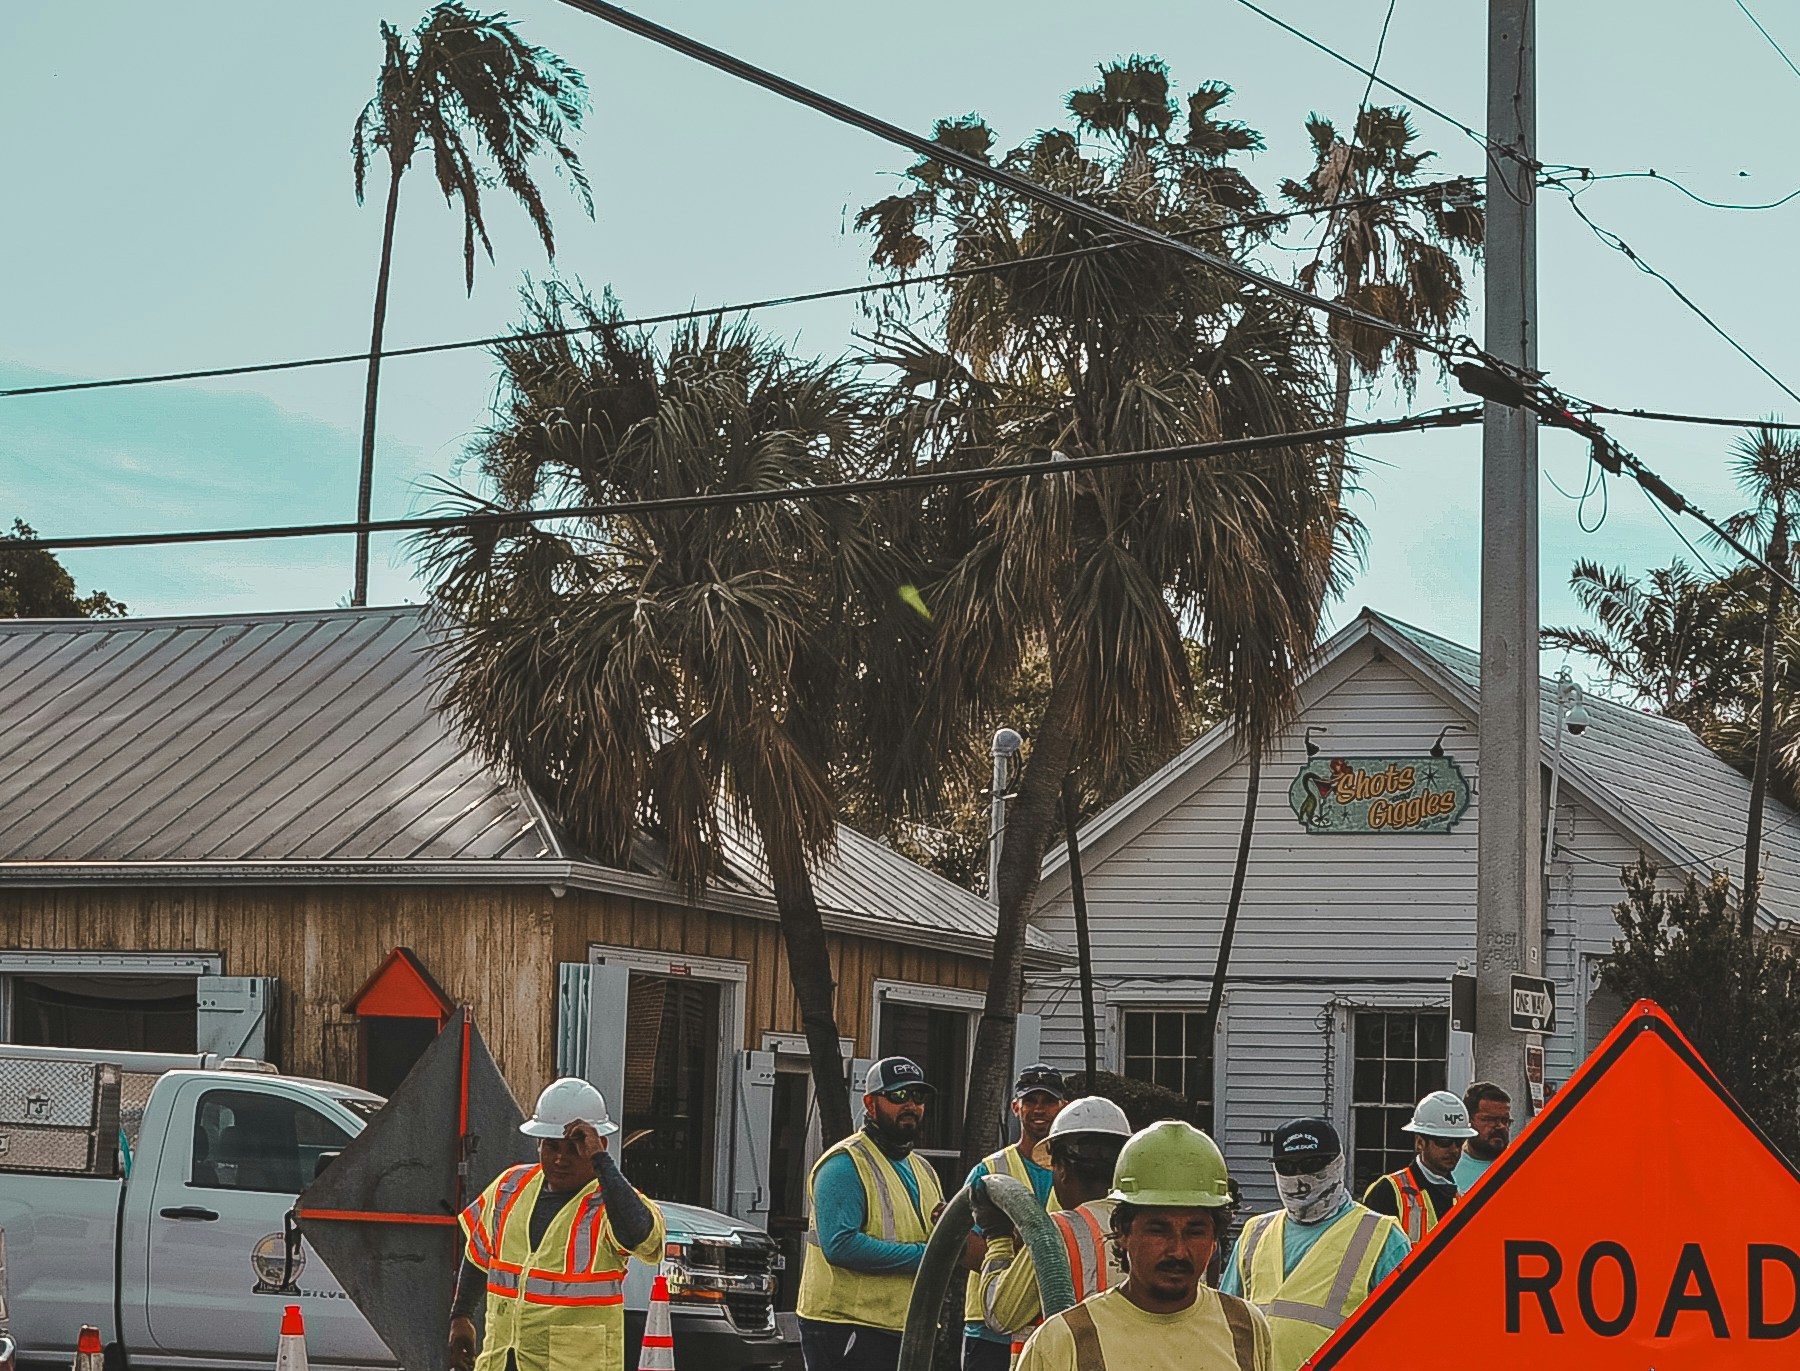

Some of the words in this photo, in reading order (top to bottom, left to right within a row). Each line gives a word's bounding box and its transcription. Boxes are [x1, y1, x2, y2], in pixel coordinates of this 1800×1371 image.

[1336, 763, 1416, 804] Shots
[1369, 788, 1456, 829] Giggles
[1515, 991, 1530, 1013] ONE
